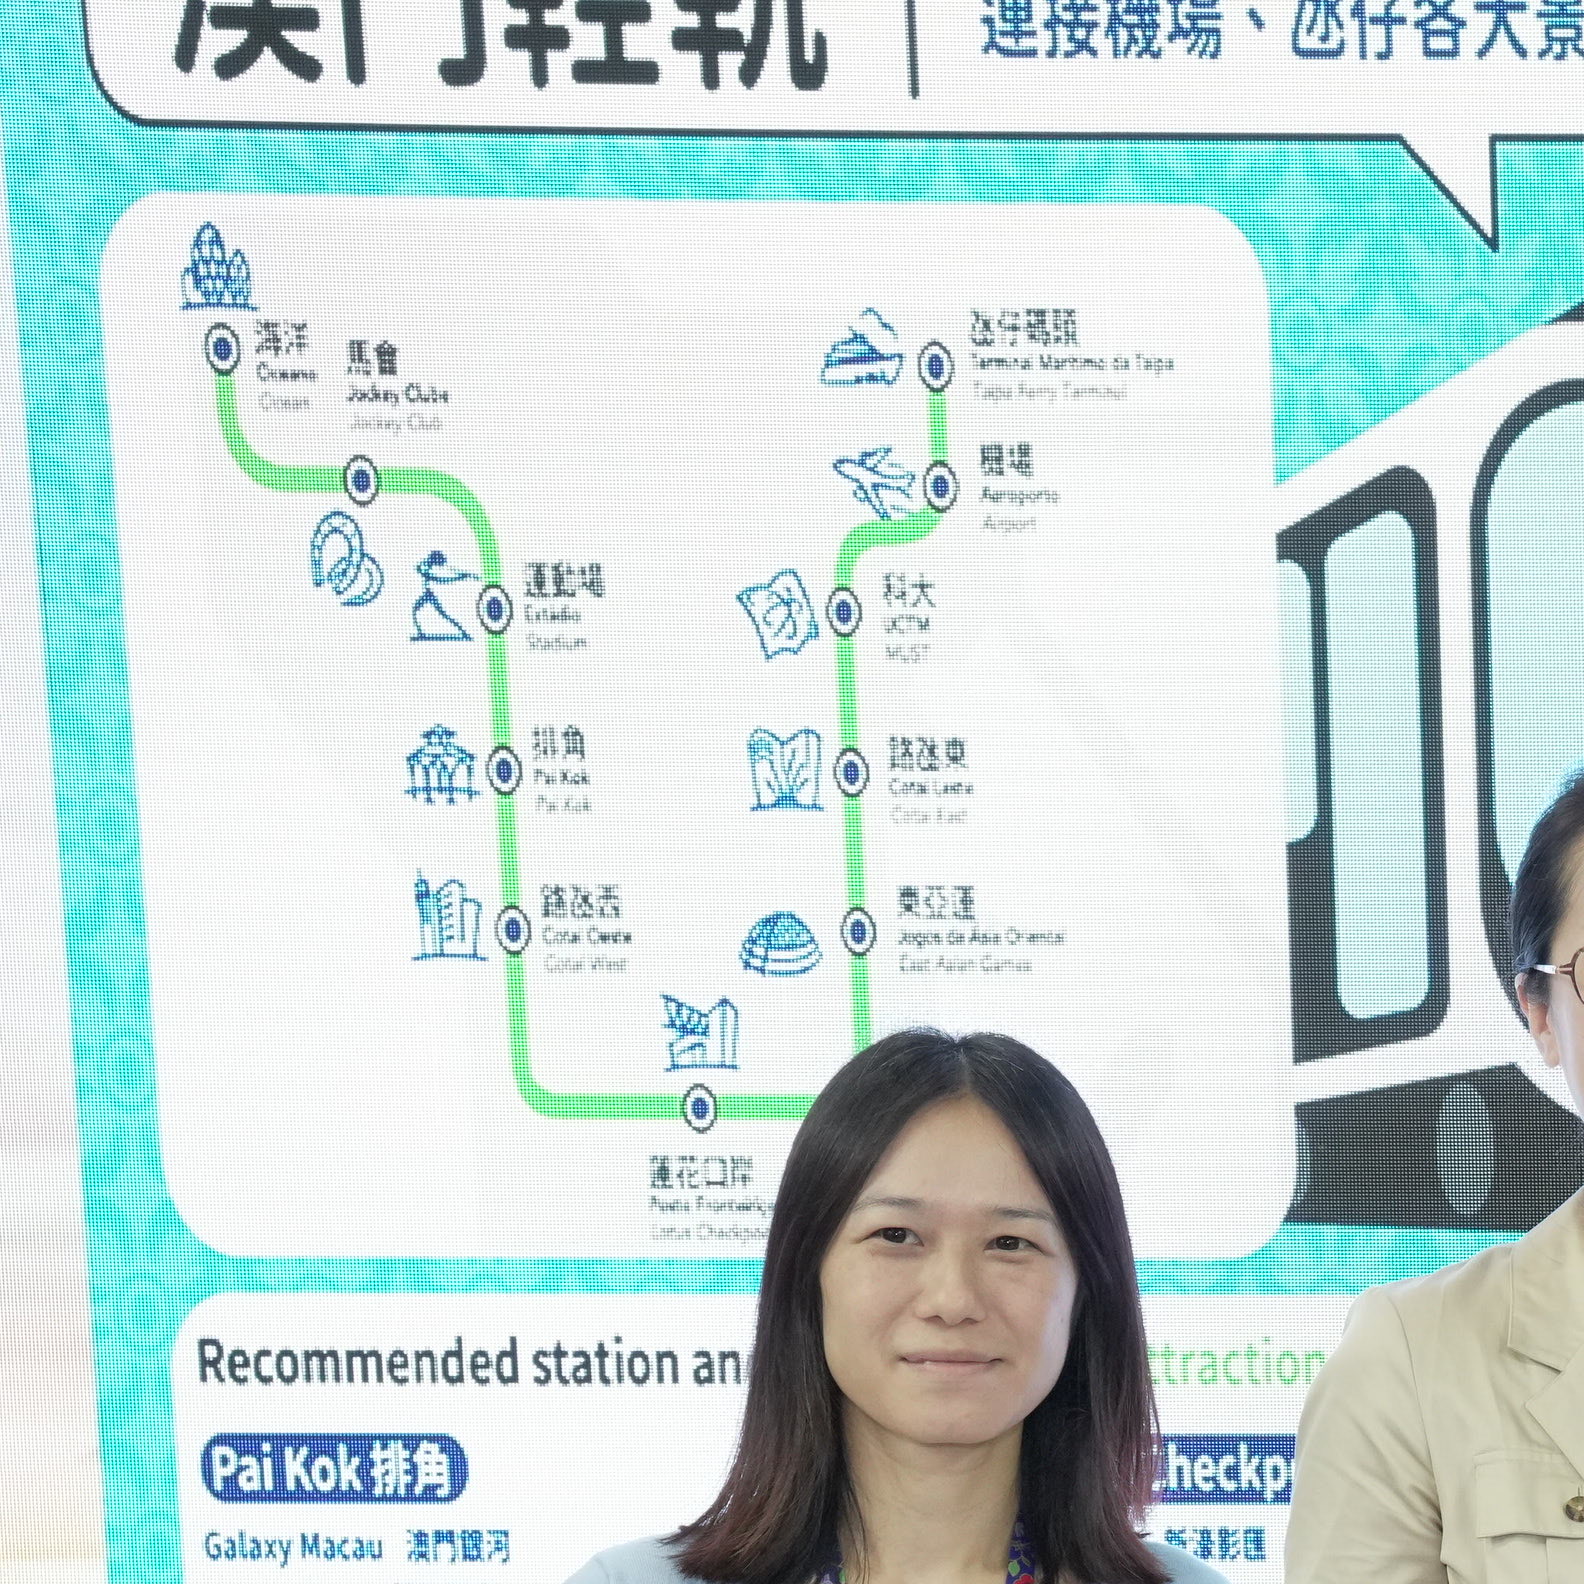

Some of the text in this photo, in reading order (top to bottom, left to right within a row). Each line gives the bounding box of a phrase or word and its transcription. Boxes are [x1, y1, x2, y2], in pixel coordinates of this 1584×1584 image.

[198, 1335, 680, 1387] Recommended station
[210, 1440, 451, 1498] Pai Kok 排角
[205, 1530, 383, 1568] Galaxy Macau
